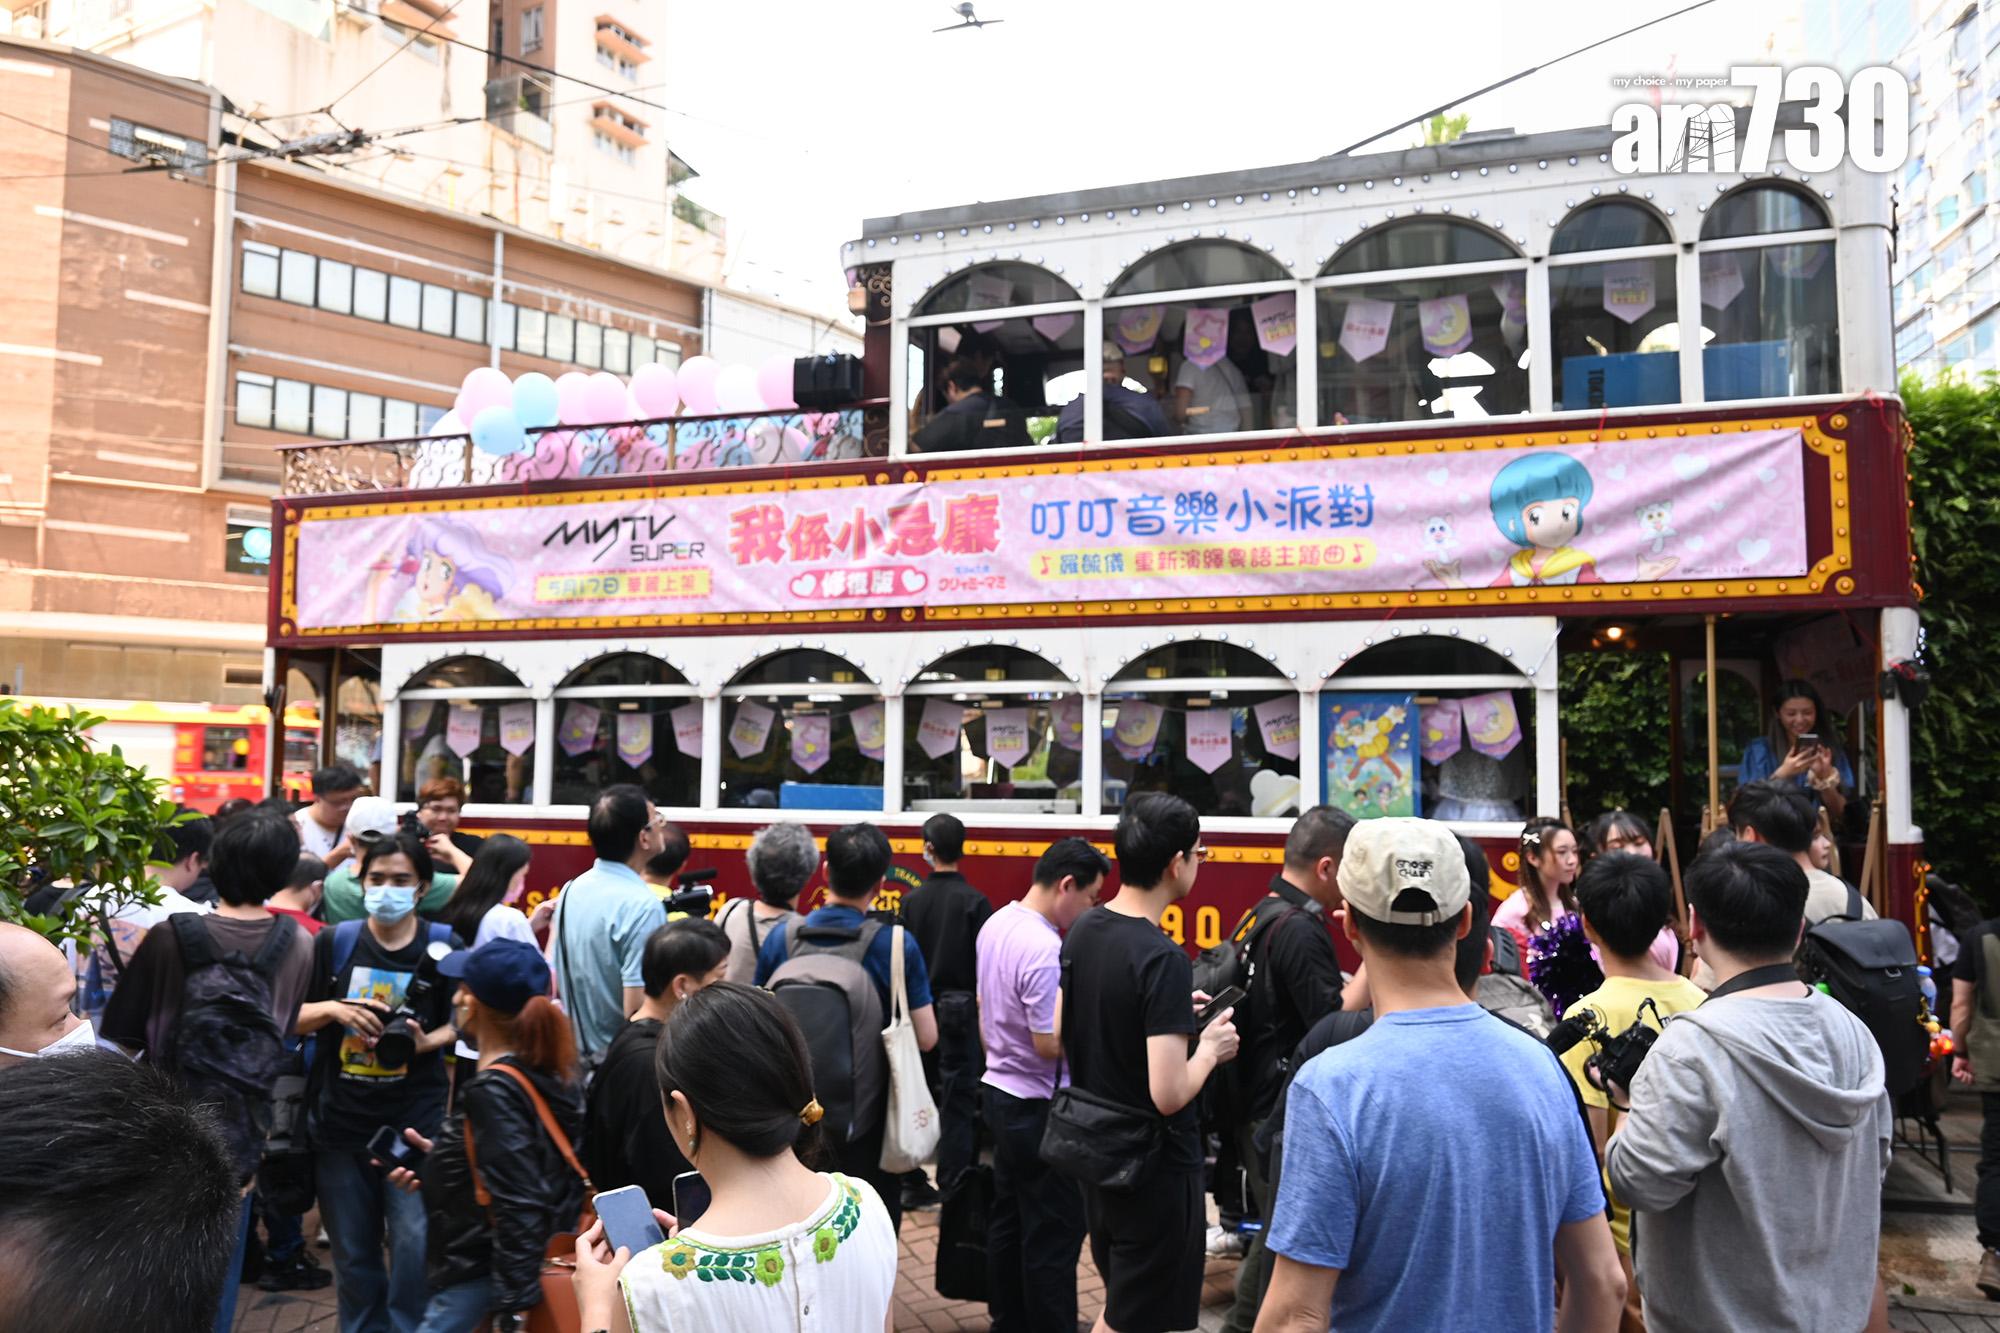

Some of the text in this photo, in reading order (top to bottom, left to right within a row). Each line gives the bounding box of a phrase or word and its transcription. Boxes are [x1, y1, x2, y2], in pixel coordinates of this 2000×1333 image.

[728, 492, 1002, 566] 我係小忌廉
[1030, 483, 1375, 541] 叮叮音樂小派對
[630, 542, 705, 562] SUPER
